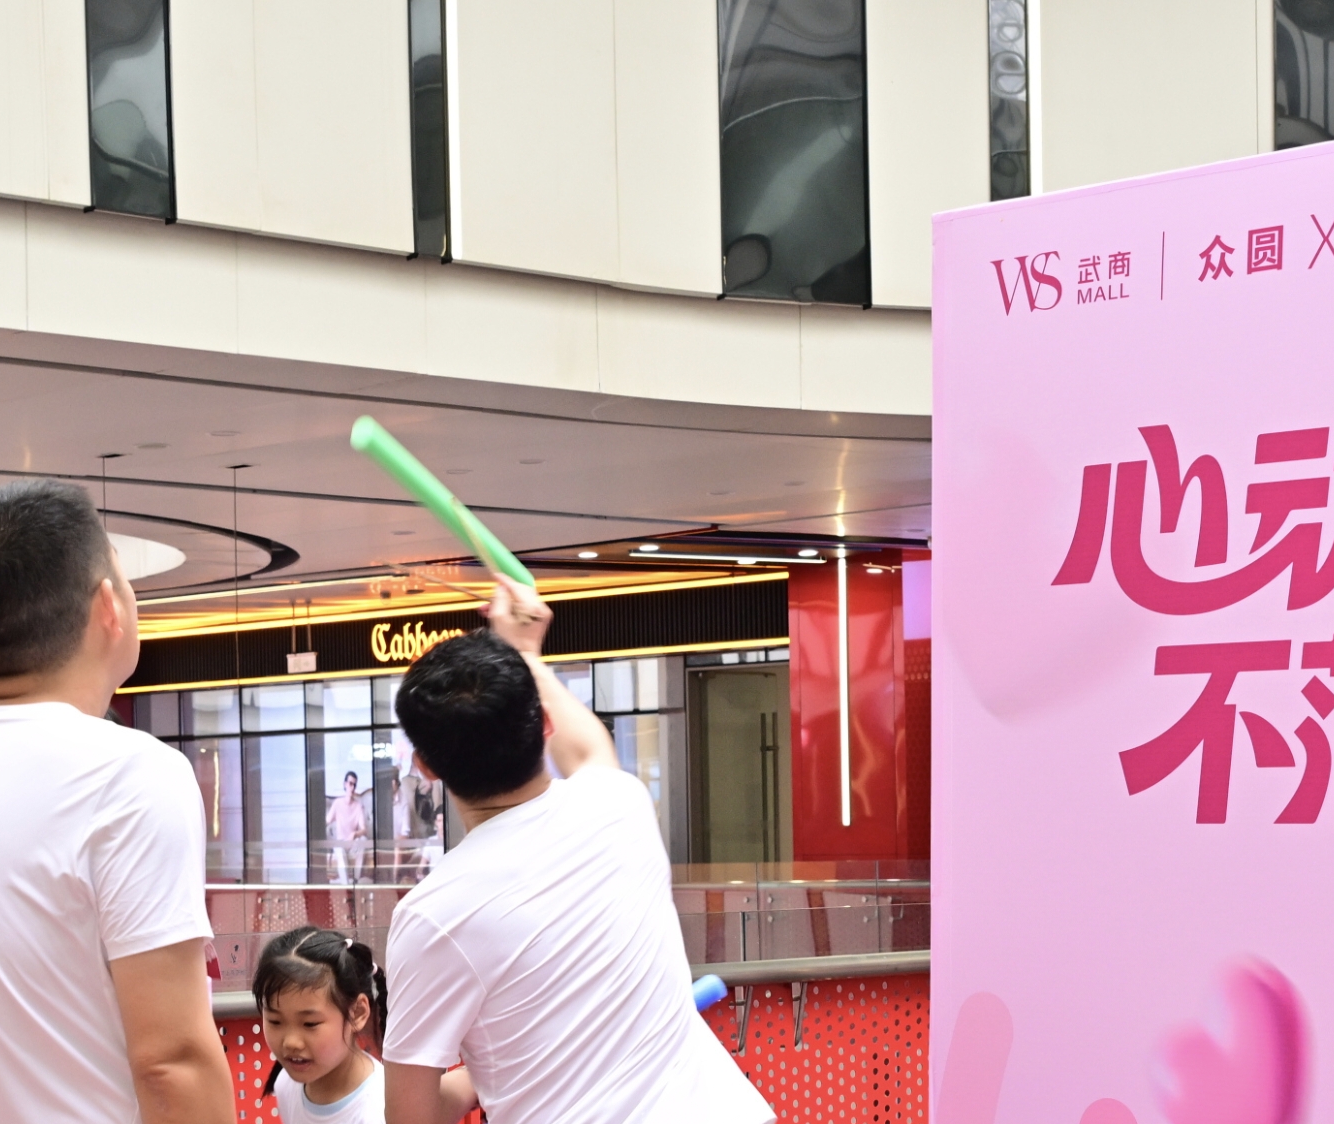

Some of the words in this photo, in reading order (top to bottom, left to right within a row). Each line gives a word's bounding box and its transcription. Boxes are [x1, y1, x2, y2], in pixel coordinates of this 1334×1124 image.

[990, 251, 1063, 316] WS
[1077, 251, 1132, 285] 武商
[1198, 225, 1284, 283] 众圆
[1077, 283, 1130, 305] MALL
